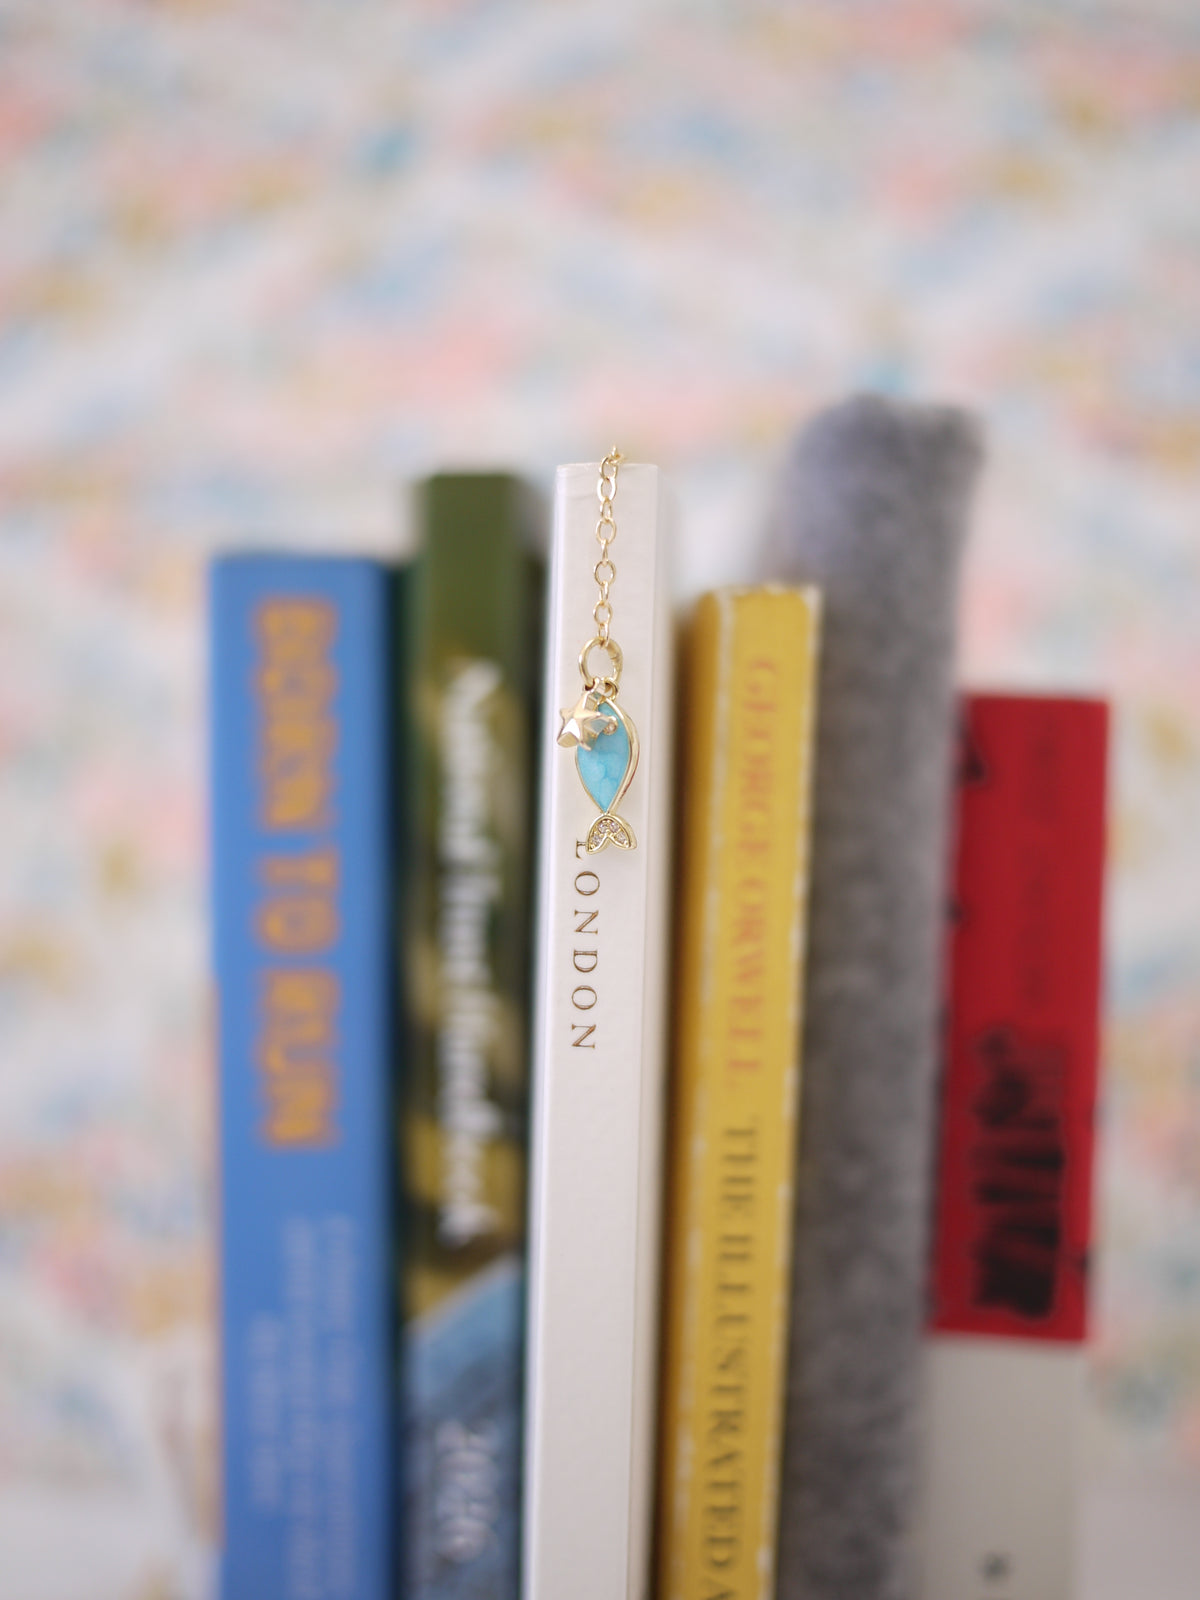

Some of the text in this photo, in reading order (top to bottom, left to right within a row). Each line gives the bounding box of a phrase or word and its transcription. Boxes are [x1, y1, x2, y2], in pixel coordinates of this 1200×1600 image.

[736, 658, 780, 866] GEORGE
[252, 845, 340, 955] TO
[571, 838, 600, 1049] LONDON
[250, 968, 340, 1148] RUN
[718, 1116, 759, 1221] THE
[704, 1232, 755, 1570] ILLUSTRATED
